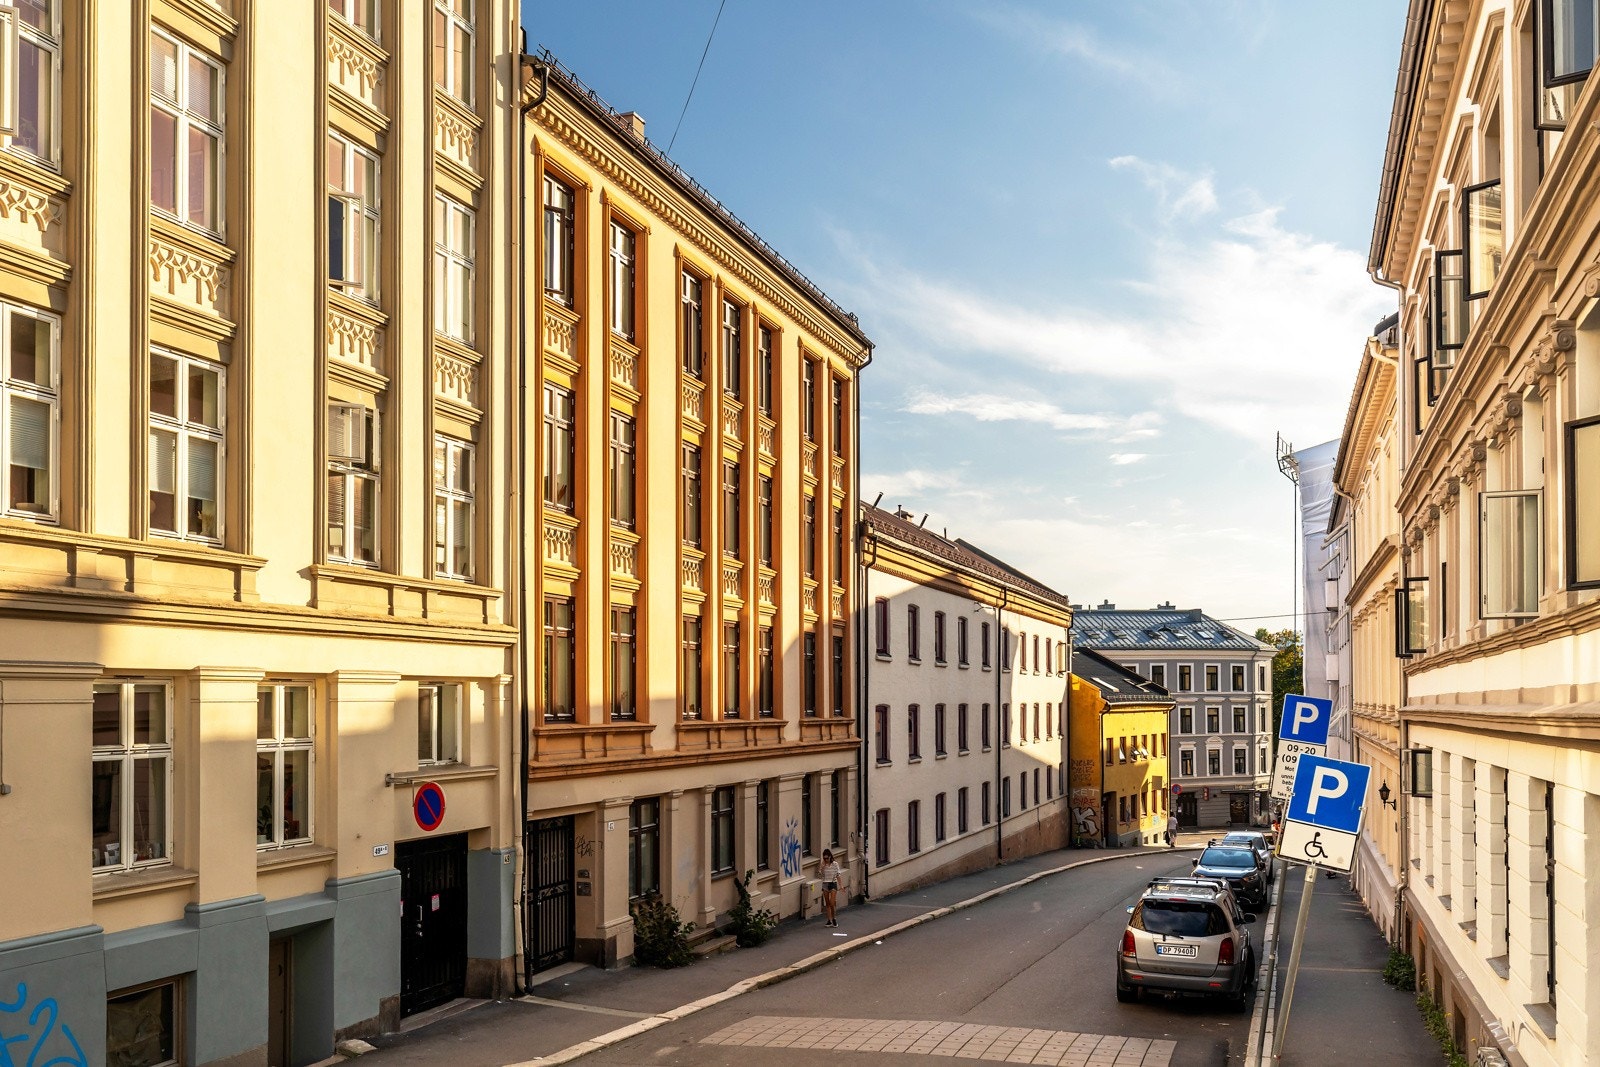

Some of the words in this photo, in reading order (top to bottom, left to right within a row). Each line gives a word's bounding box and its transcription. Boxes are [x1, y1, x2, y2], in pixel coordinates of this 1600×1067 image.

[1292, 701, 1319, 735] P
[1306, 765, 1349, 815] P
[1173, 947, 1194, 955] 79408
